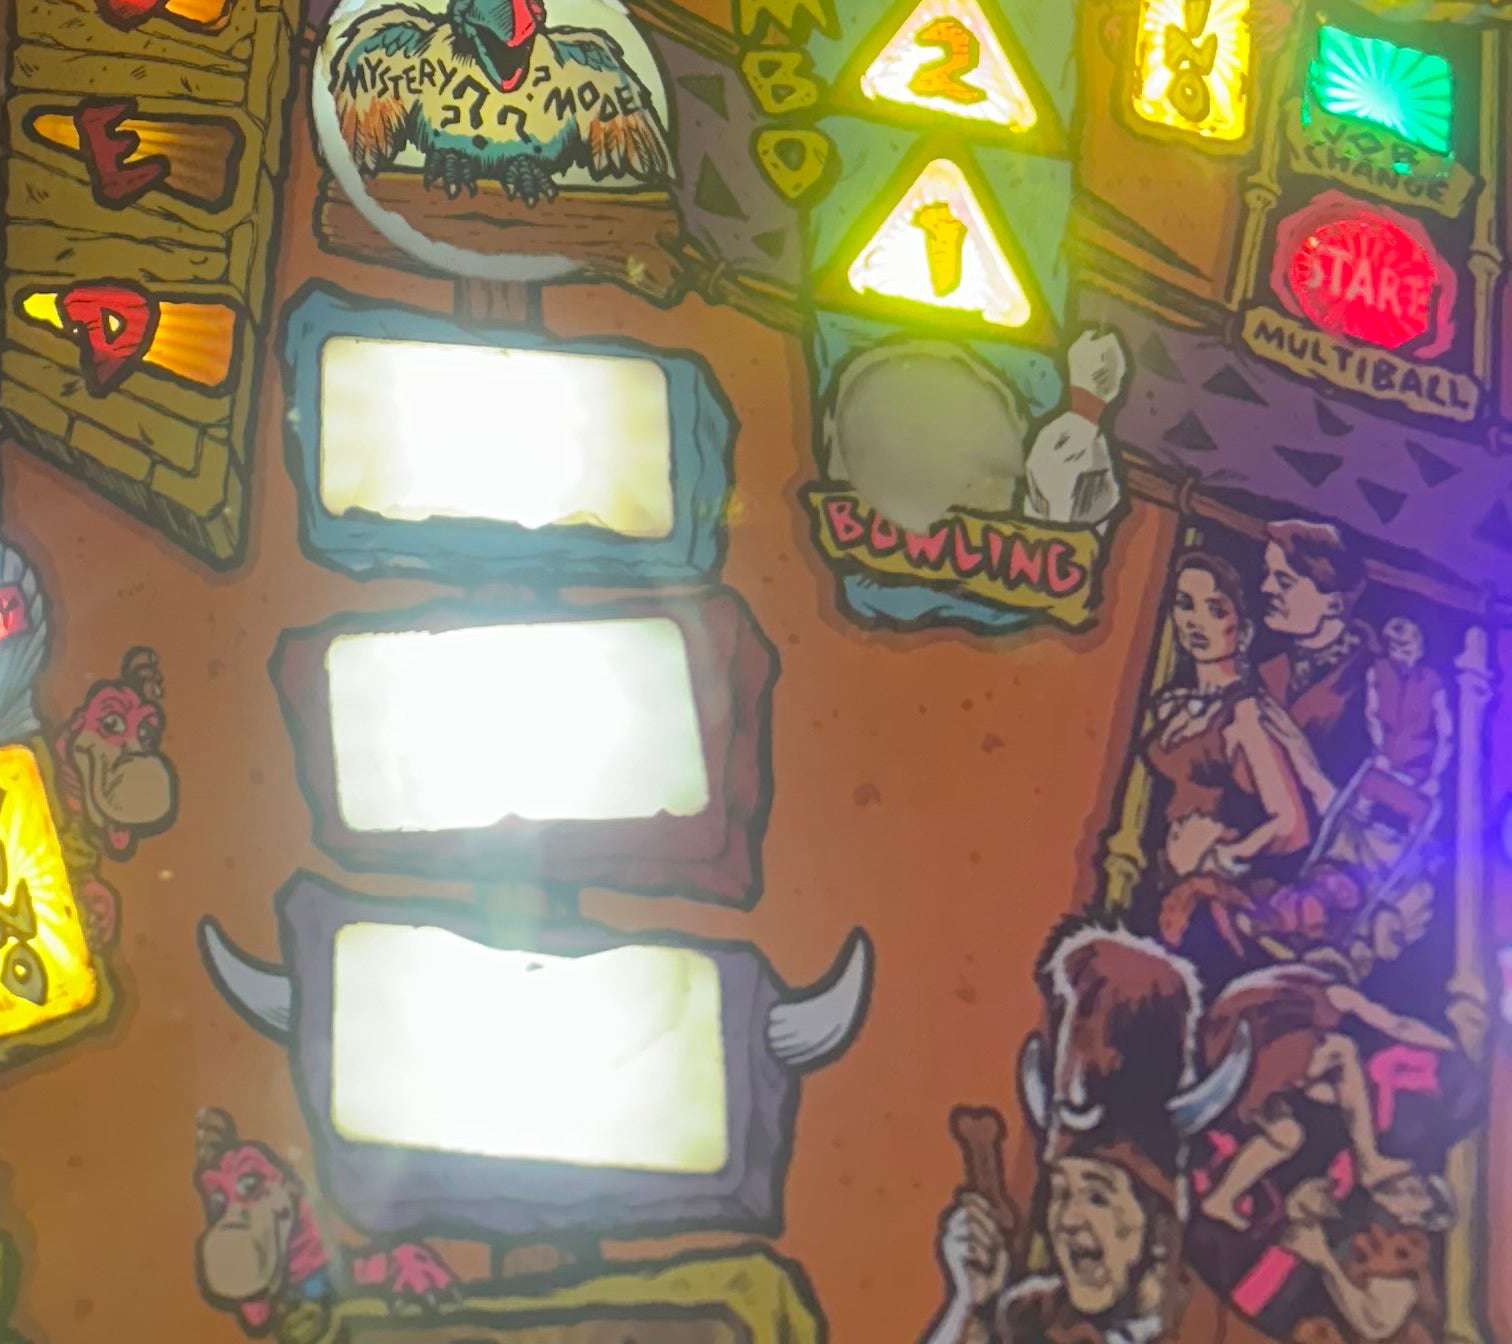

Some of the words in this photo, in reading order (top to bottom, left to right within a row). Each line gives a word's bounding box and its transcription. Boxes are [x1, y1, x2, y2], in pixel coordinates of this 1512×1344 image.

[340, 56, 458, 101] MYSTERY
[542, 79, 639, 124] MODE
[906, 15, 988, 105] 2
[1303, 144, 1450, 206] CHANGE
[1320, 124, 1421, 167] JOB
[912, 201, 969, 299] 1
[1304, 249, 1438, 315] START
[1254, 320, 1471, 410] MULTIBALL
[825, 499, 1084, 595] BOWLING
